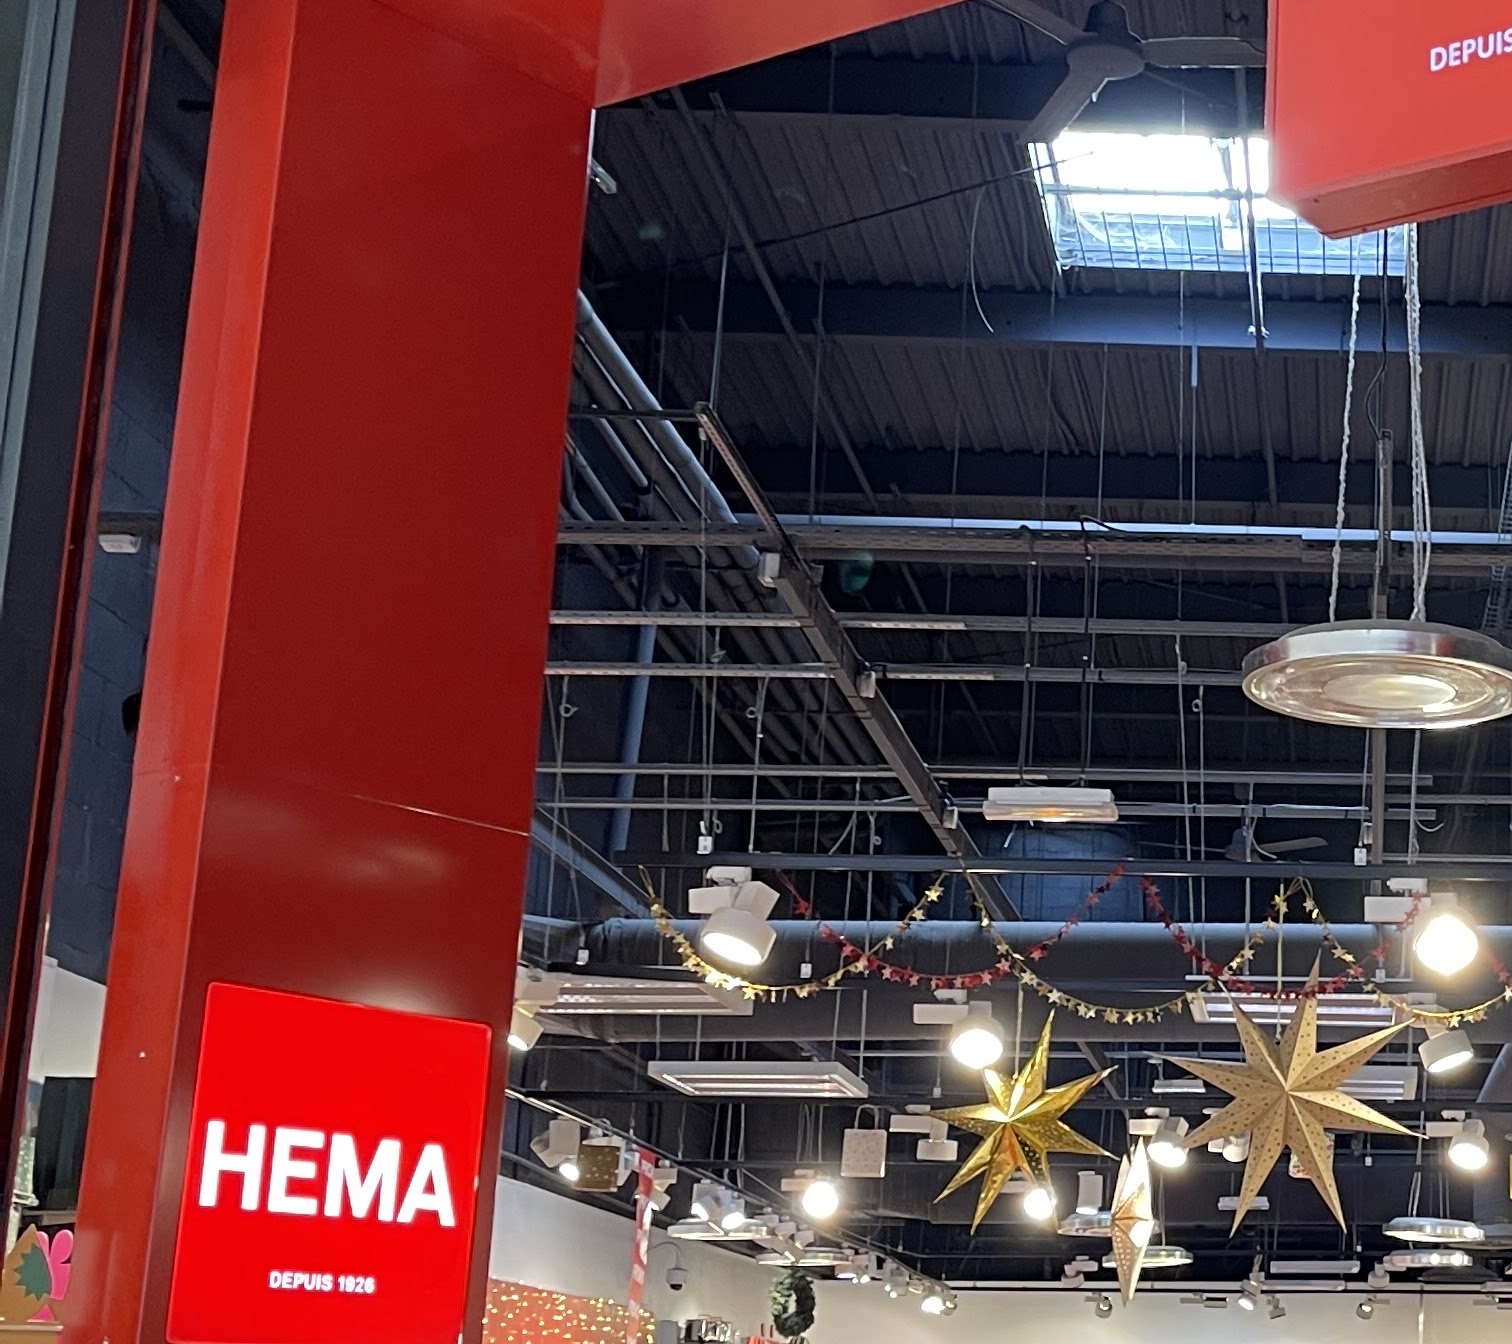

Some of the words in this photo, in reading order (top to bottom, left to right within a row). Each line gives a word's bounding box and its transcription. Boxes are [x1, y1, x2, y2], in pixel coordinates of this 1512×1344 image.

[199, 1119, 456, 1227] HEMA
[269, 1270, 333, 1292] DEPUIS
[337, 1275, 376, 1294] 1926
